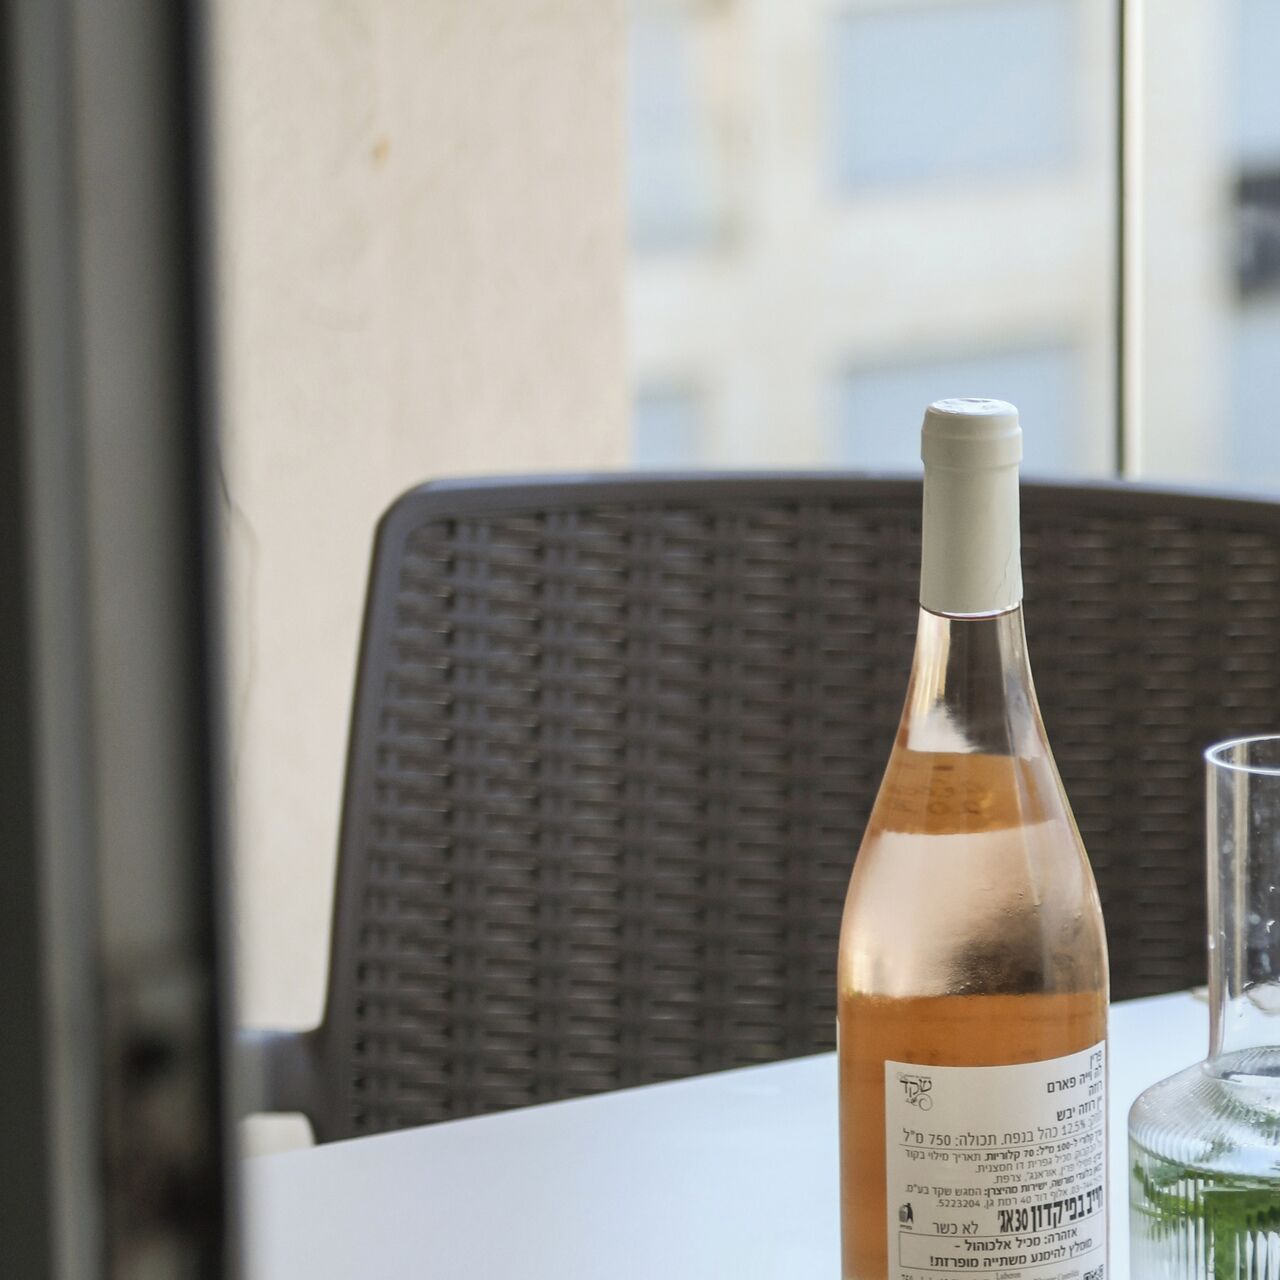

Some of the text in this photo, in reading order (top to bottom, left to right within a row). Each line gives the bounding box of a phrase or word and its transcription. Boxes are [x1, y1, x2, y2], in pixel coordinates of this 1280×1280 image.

[899, 1078, 933, 1099] שקד
[1047, 1076, 1076, 1093] פארם
[1057, 1106, 1075, 1121] יבש
[1079, 1100, 1095, 1115] רוזה
[903, 1127, 924, 1144] מ"ל
[928, 1134, 951, 1146] 750
[955, 1132, 997, 1146] תכולה:
[1001, 1130, 1034, 1145] בנפח.
[1038, 1126, 1058, 1140] כהל
[905, 1149, 925, 1161] בקוד
[928, 1151, 949, 1161] מילוי
[1023, 1149, 1034, 1158] 70
[1036, 1144, 1055, 1156] מ"ל:
[952, 1152, 981, 1164] תאריך
[1028, 1156, 1053, 1169] גפרית
[1016, 1161, 1024, 1171] דו
[931, 1186, 952, 1198] שקד
[954, 1187, 982, 1197] המגש
[997, 1197, 1017, 1207] רמת
[1020, 1195, 1032, 1204] 40
[1086, 1185, 1103, 1214] חייב
[1031, 1194, 1085, 1233] בפיקדון
[932, 1220, 979, 1234] לא כשר
[964, 1227, 1078, 1252] אזהרה: מכיל אלכוהול
[930, 1238, 1093, 1268] מומלץ להימנע משתייה מופרזת!
